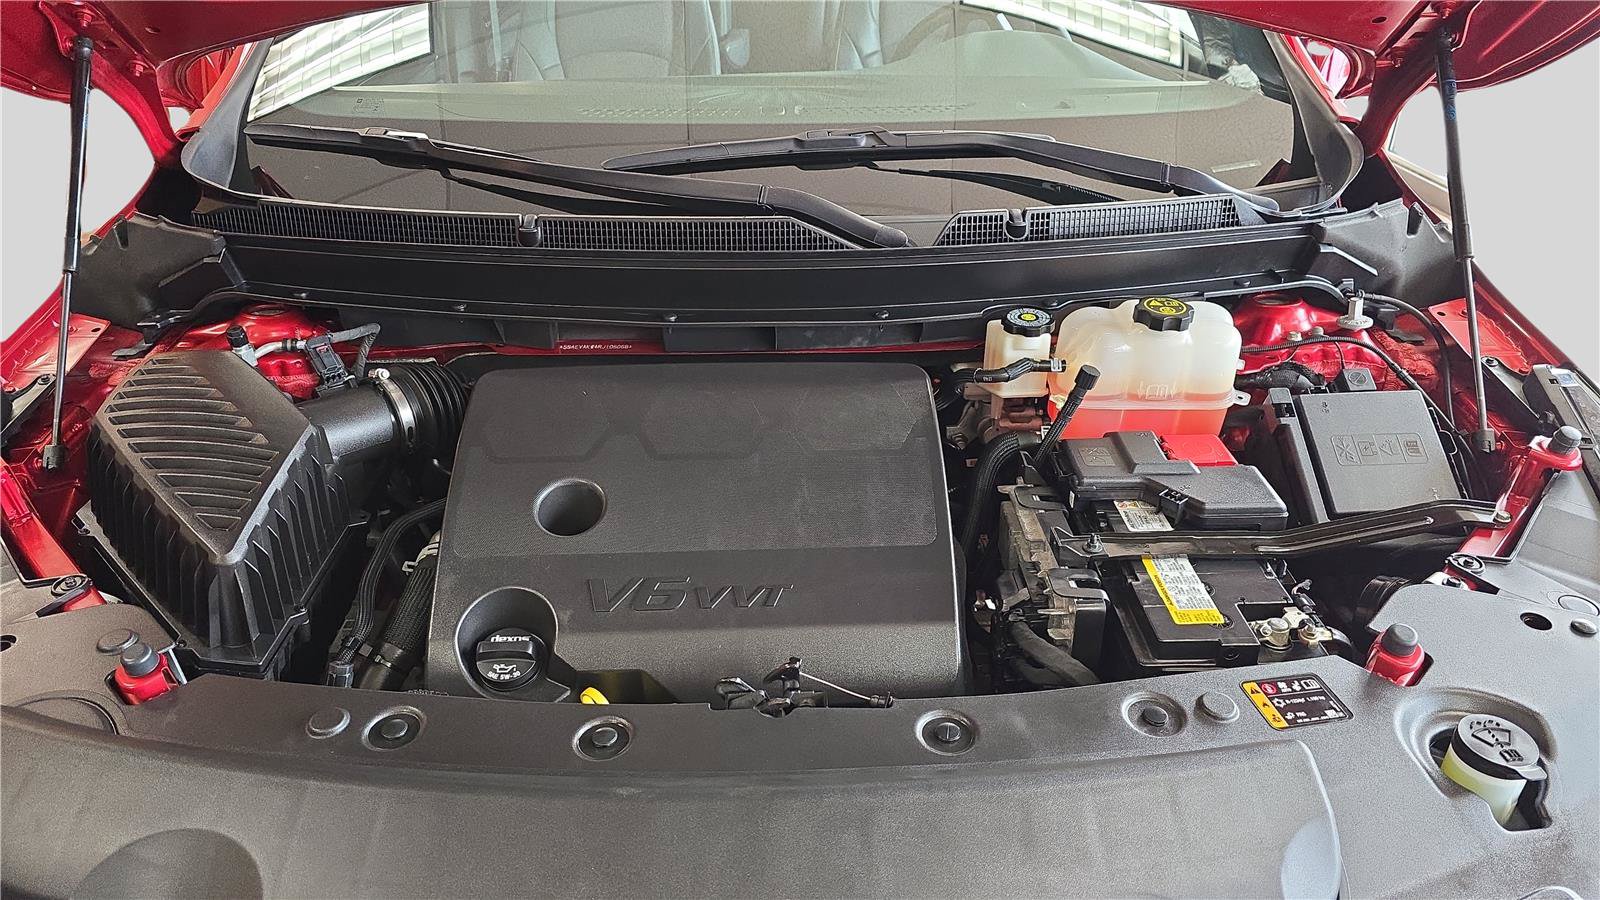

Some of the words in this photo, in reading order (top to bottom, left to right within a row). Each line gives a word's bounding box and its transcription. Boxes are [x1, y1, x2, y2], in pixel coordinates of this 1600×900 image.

[587, 576, 690, 612] V6
[694, 583, 794, 608] VVT
[487, 671, 499, 680] SAE
[500, 671, 521, 680] 5W-30
